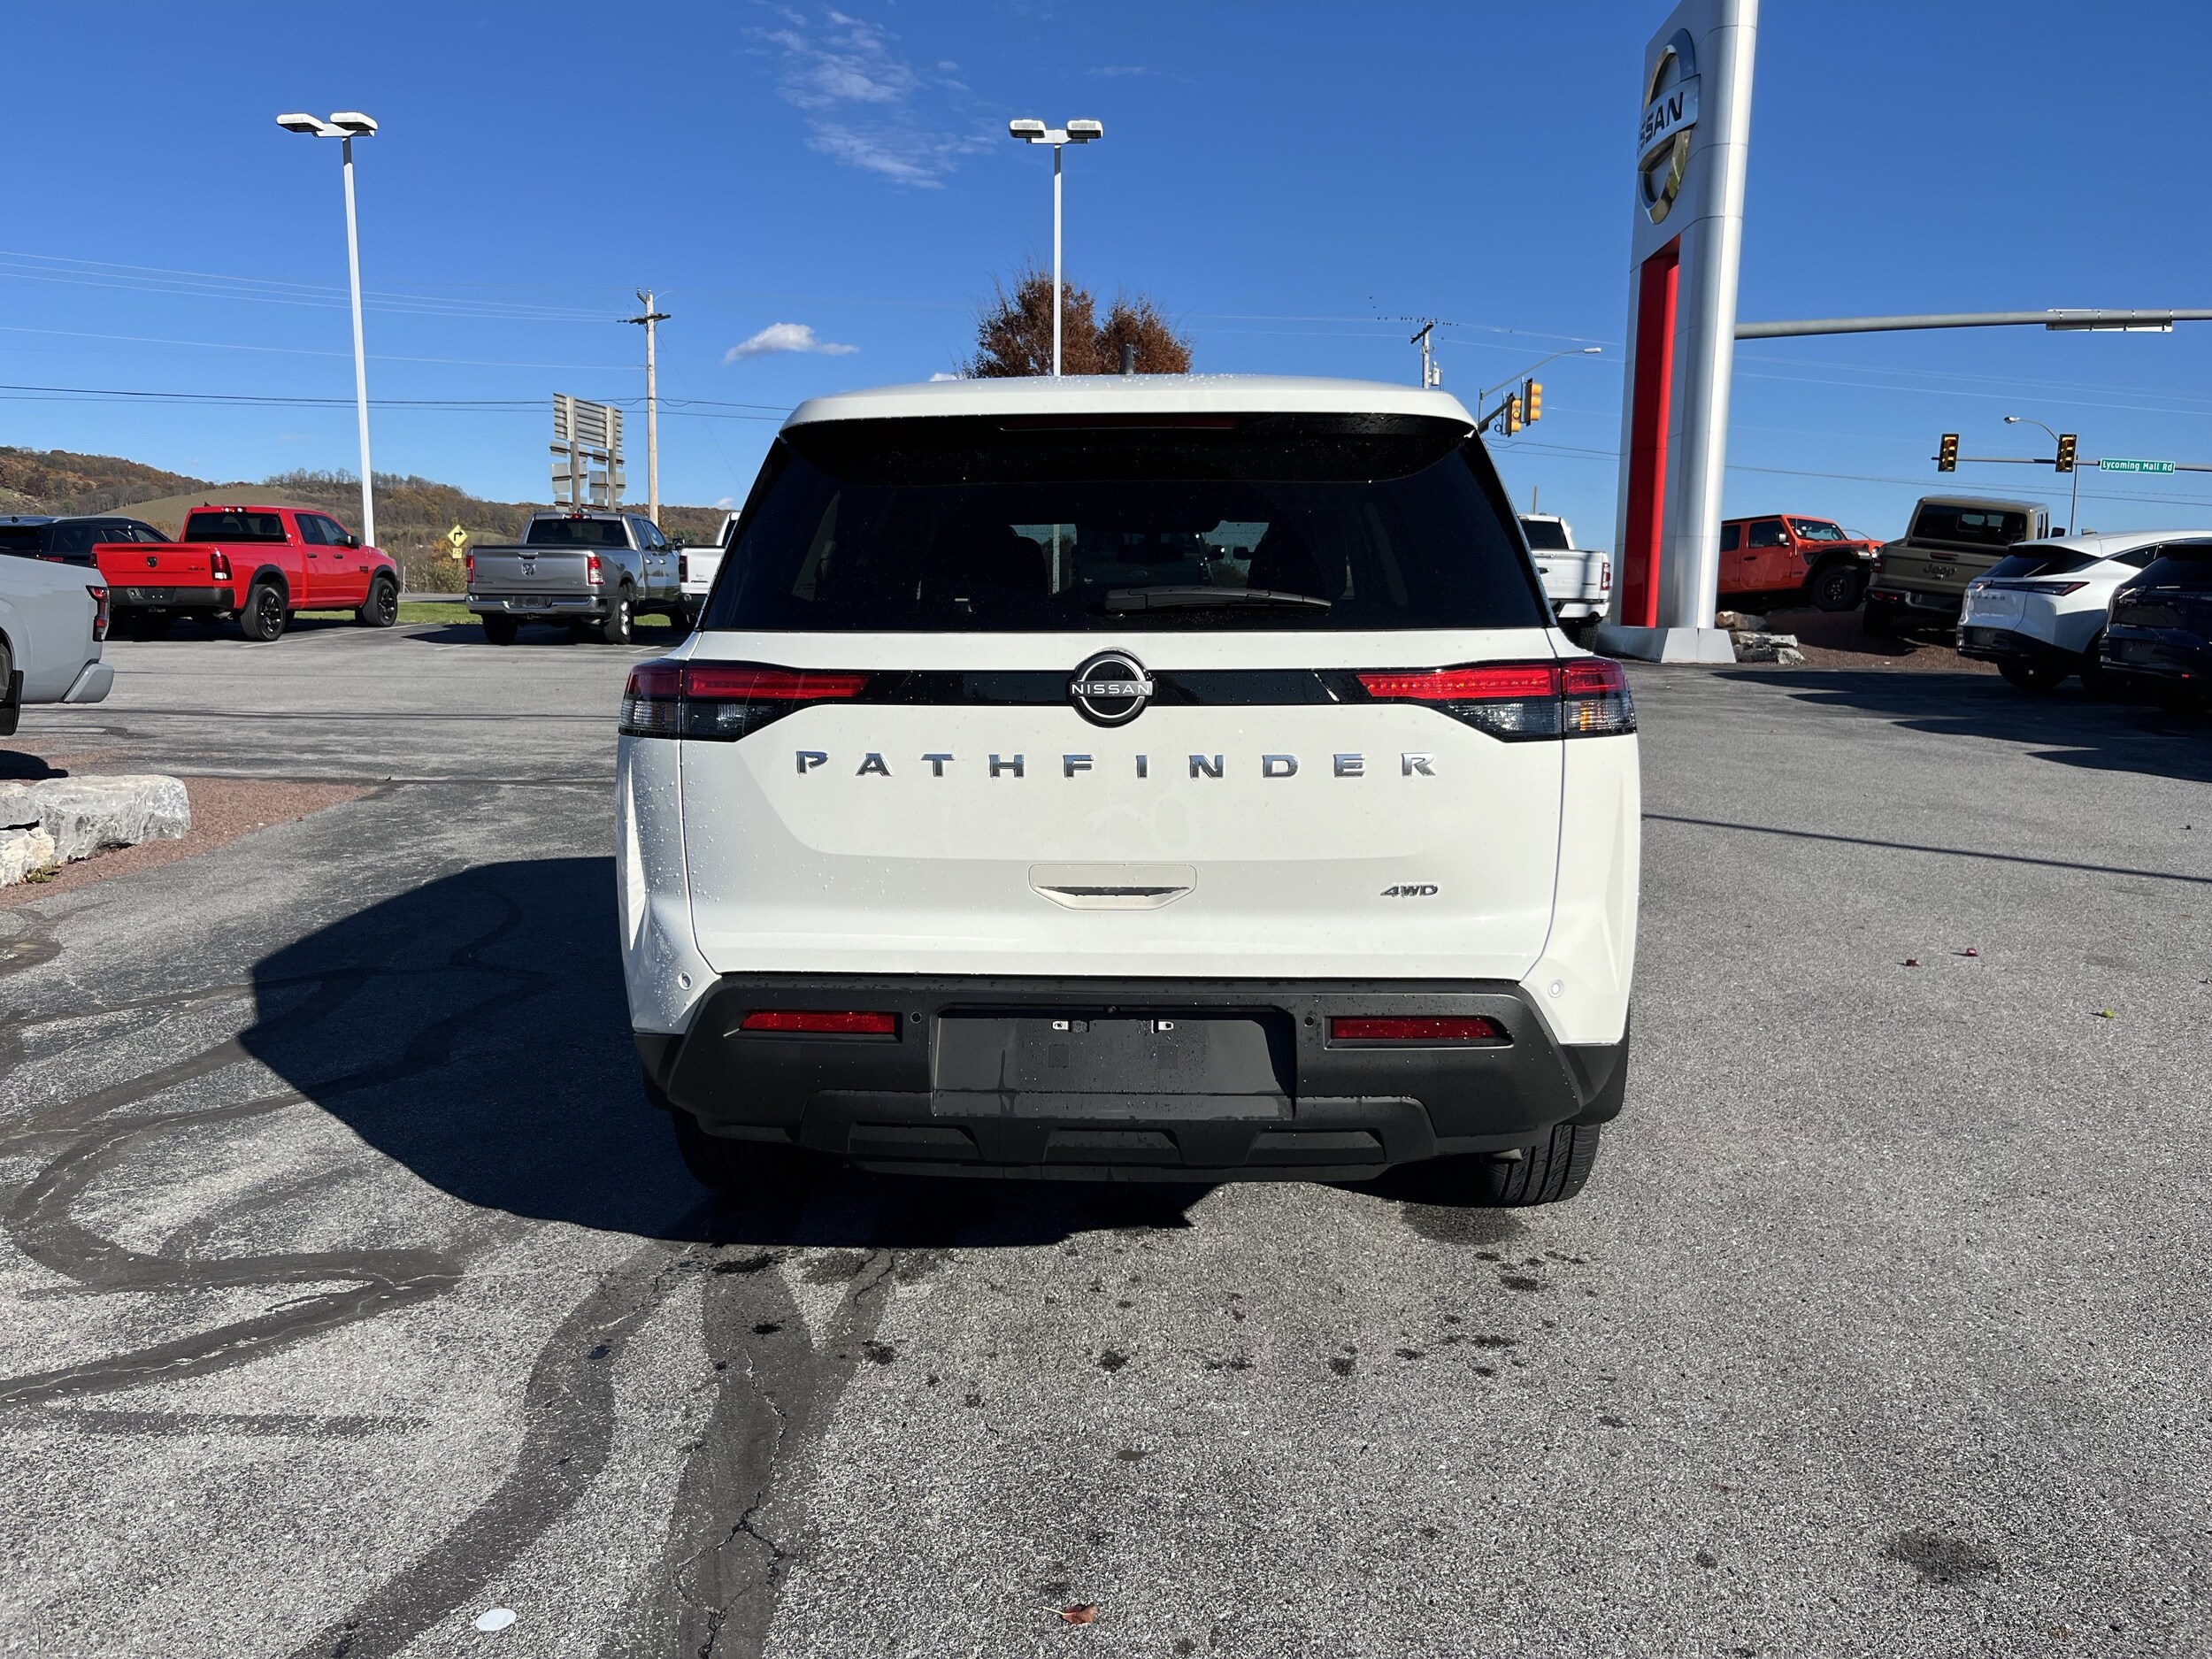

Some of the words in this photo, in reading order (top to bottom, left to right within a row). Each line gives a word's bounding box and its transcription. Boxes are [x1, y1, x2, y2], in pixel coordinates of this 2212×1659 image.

[1640, 91, 1684, 151] SSAN
[2102, 460, 2140, 472] Lycoming
[2142, 462, 2160, 471] Mall
[2162, 463, 2173, 472] Rd
[1071, 684, 1149, 695] NISSAN
[795, 750, 1437, 779] PATHFINDER
[1380, 884, 1439, 897] 4WD
